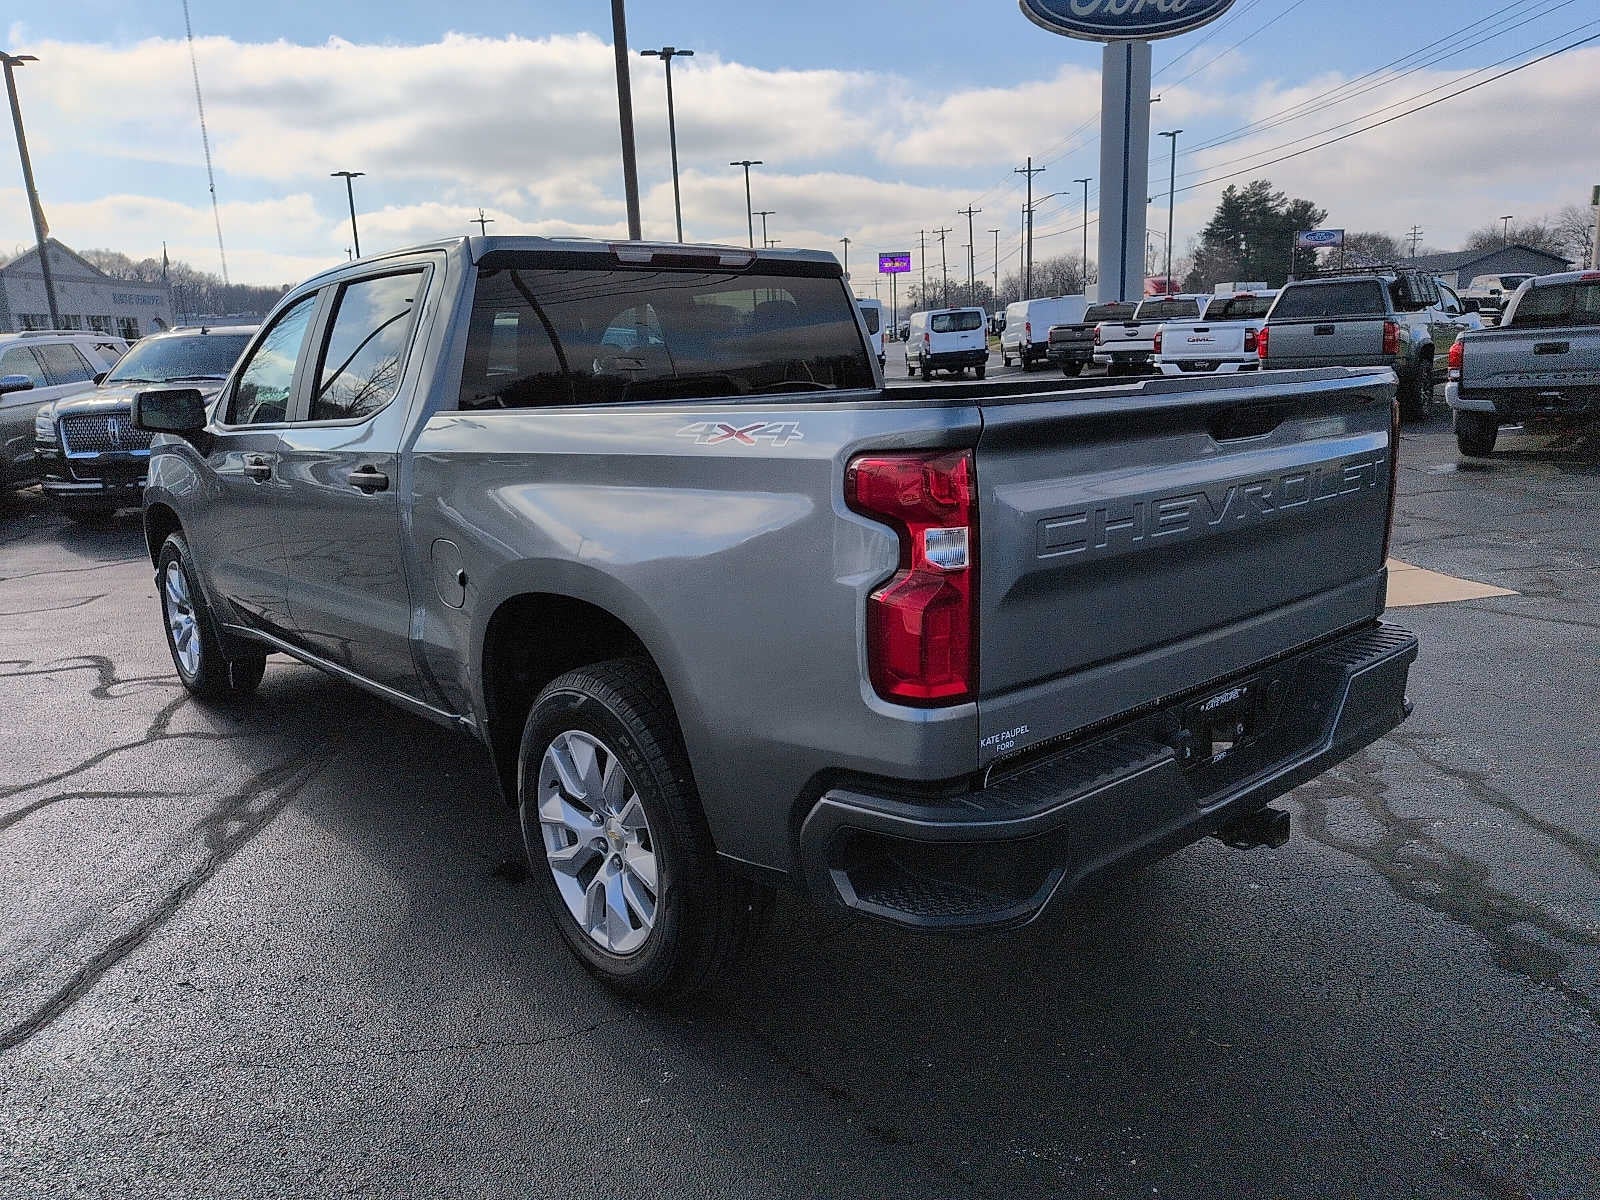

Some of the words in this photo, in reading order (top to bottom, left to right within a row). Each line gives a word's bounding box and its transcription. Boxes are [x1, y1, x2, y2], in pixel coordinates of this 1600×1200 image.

[1037, 458, 1384, 559] CHEVROLET
[980, 734, 1000, 748] KATE
[1001, 725, 1030, 740] FAUPEL
[996, 741, 1015, 752] FORD
